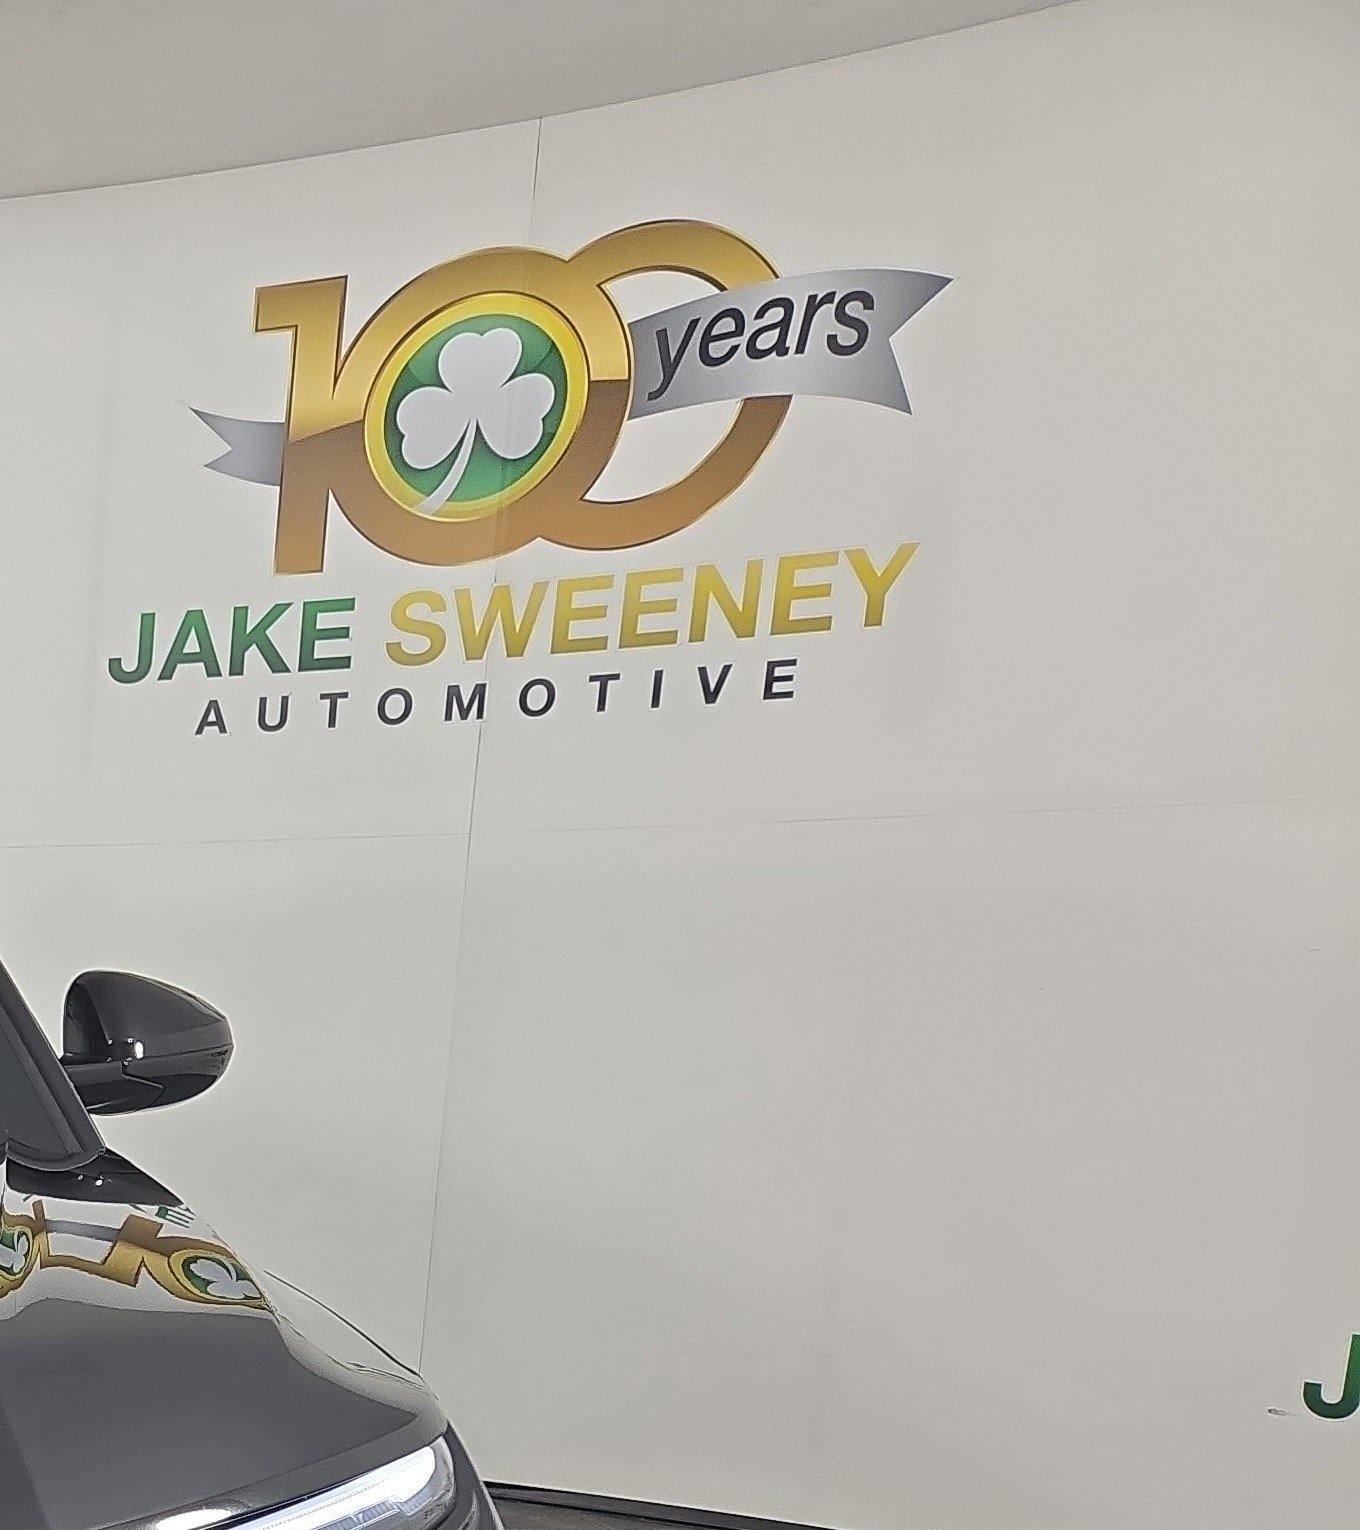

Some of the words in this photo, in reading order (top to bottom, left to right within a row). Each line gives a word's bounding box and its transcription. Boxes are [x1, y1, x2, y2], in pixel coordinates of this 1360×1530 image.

[645, 286, 875, 401] years
[108, 597, 357, 684] JAKE
[385, 541, 921, 667] SWEENEY
[194, 658, 798, 736] AUTOMOTIVE
